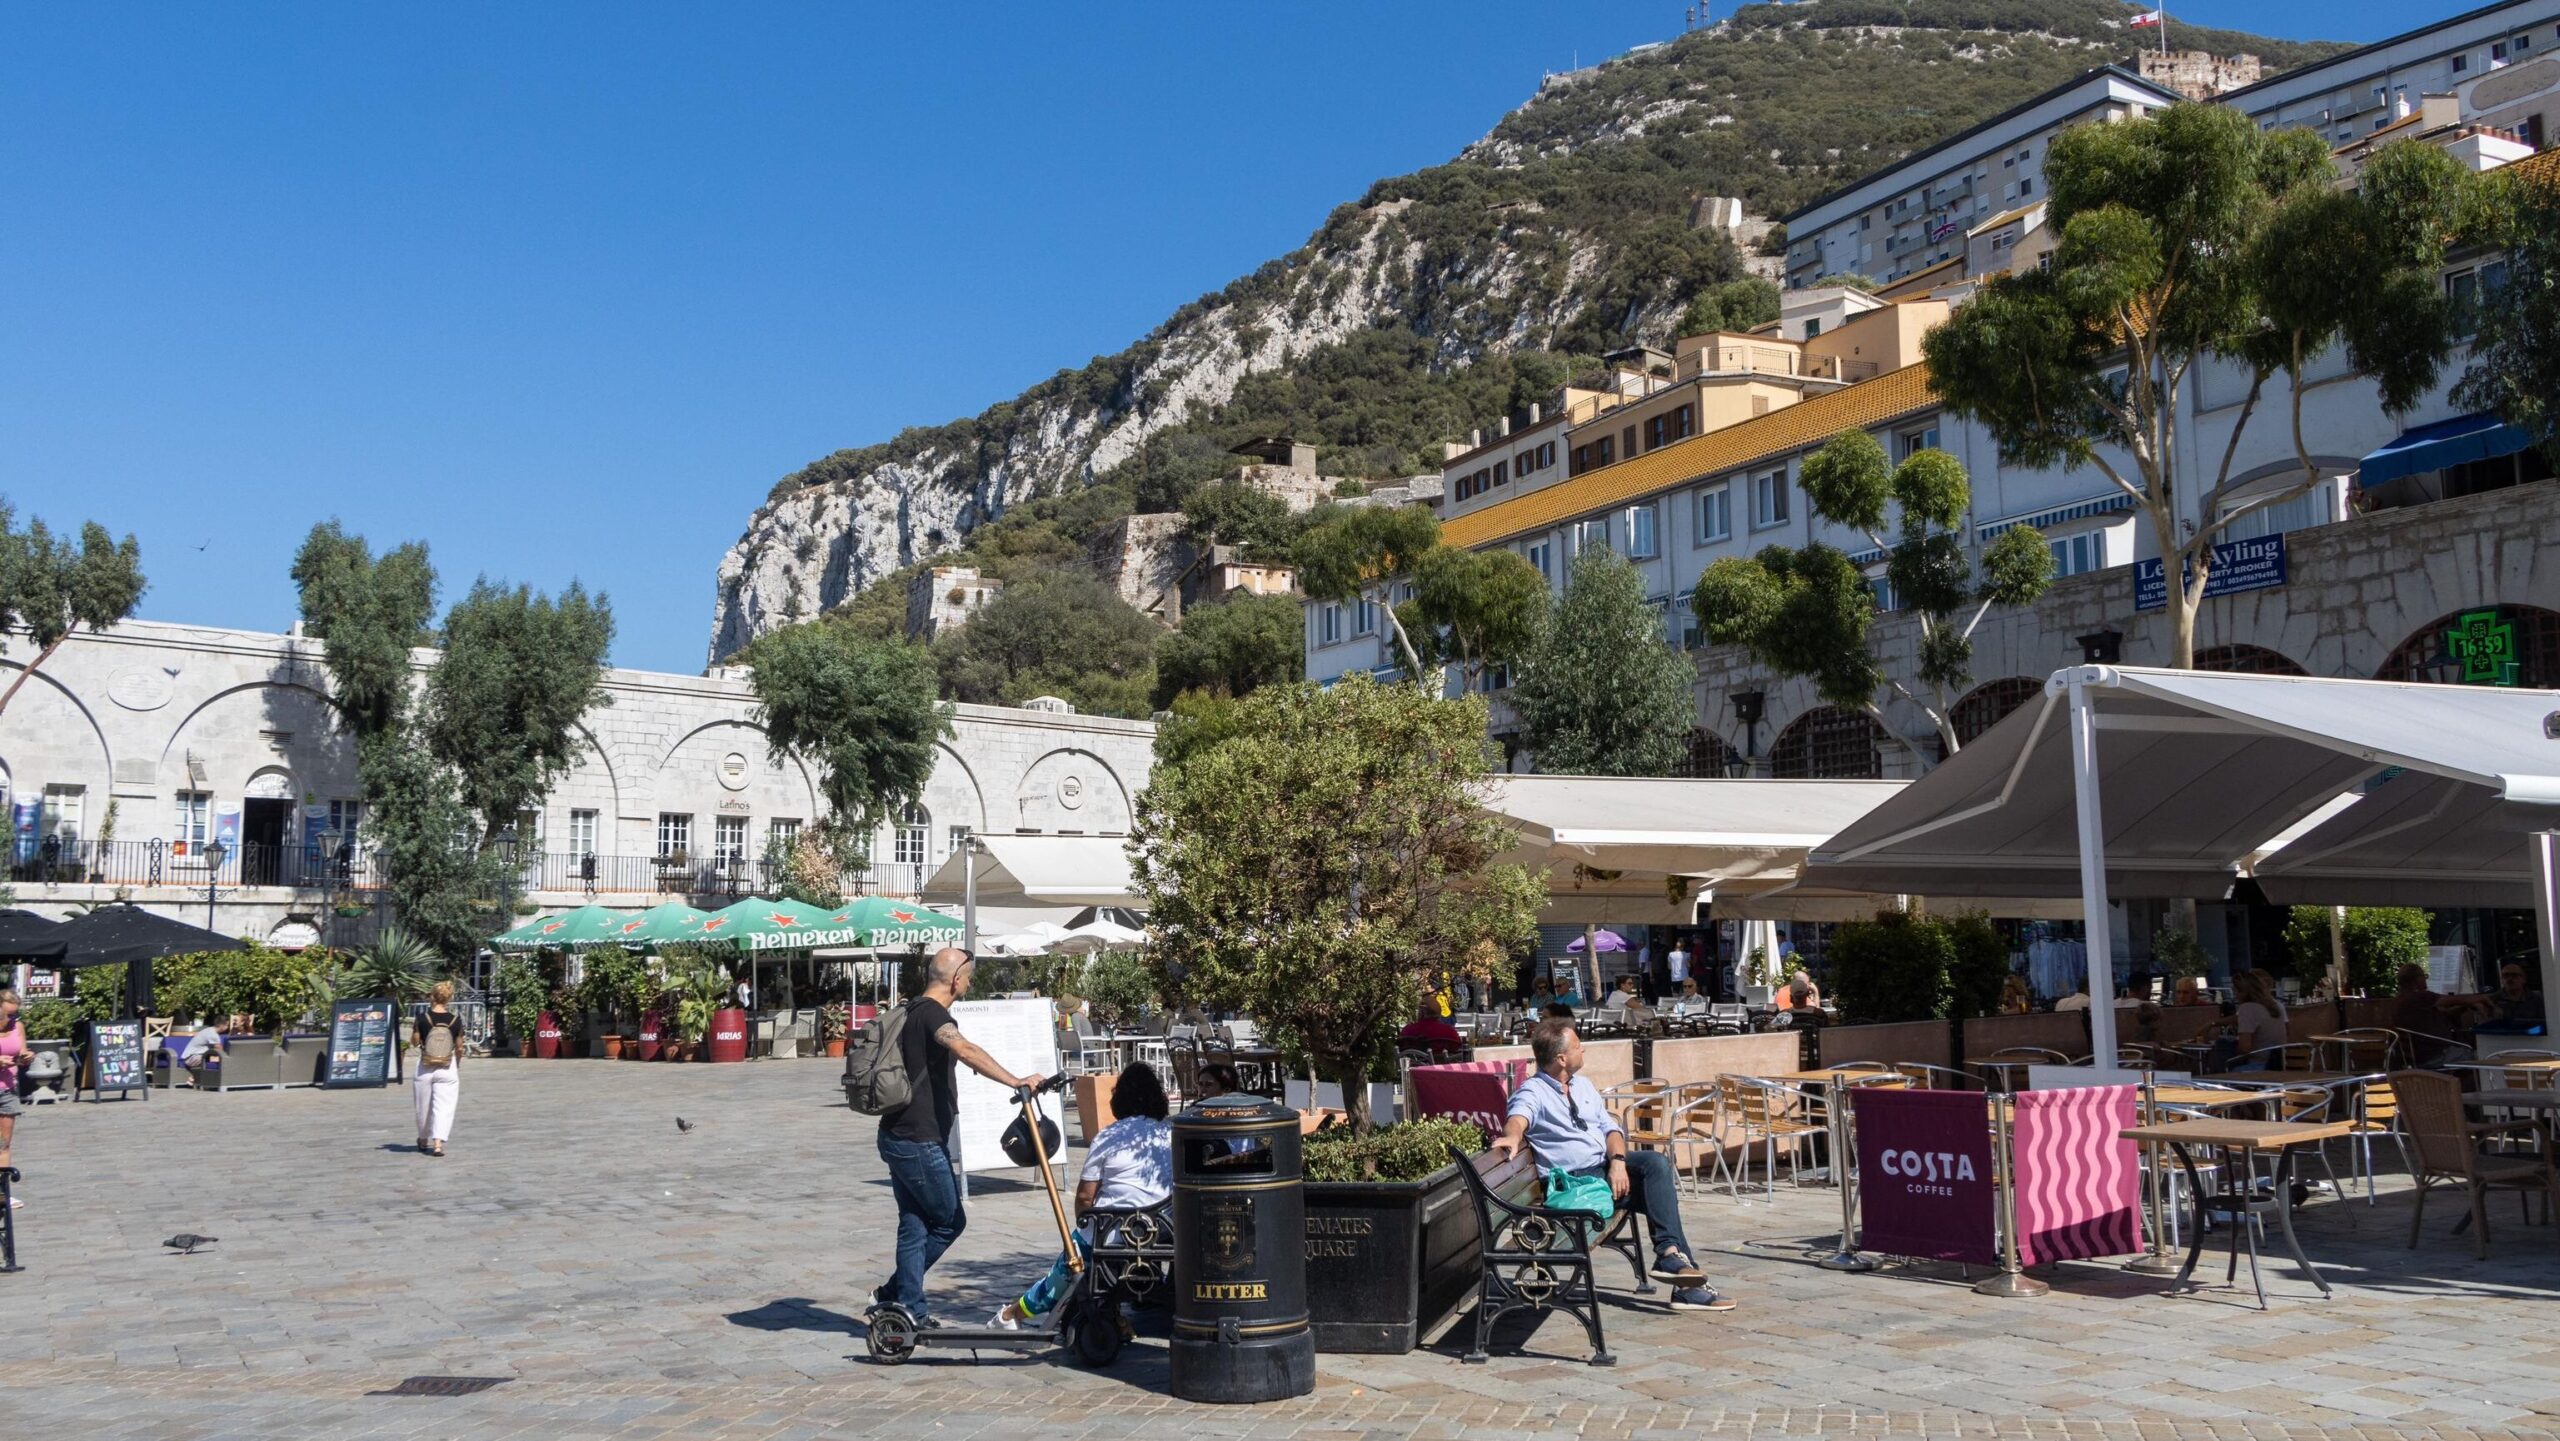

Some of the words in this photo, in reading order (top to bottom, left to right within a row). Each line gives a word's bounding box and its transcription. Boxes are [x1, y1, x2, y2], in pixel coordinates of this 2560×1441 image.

[2209, 541, 2278, 568] Ayling
[2235, 561, 2272, 574] BROKER
[2459, 636, 2502, 657] 16:59
[747, 926, 855, 949] Heineken
[870, 924, 965, 946] Heineken
[30, 976, 53, 985] OPEN
[102, 1060, 139, 1073] LOVE
[1442, 1110, 1503, 1134] OSTA
[1881, 1149, 1976, 1182] COSTA
[1907, 1184, 1953, 1196] COFFEE
[1304, 1217, 1372, 1234] EMATES
[1195, 1284, 1267, 1299] LITTER
